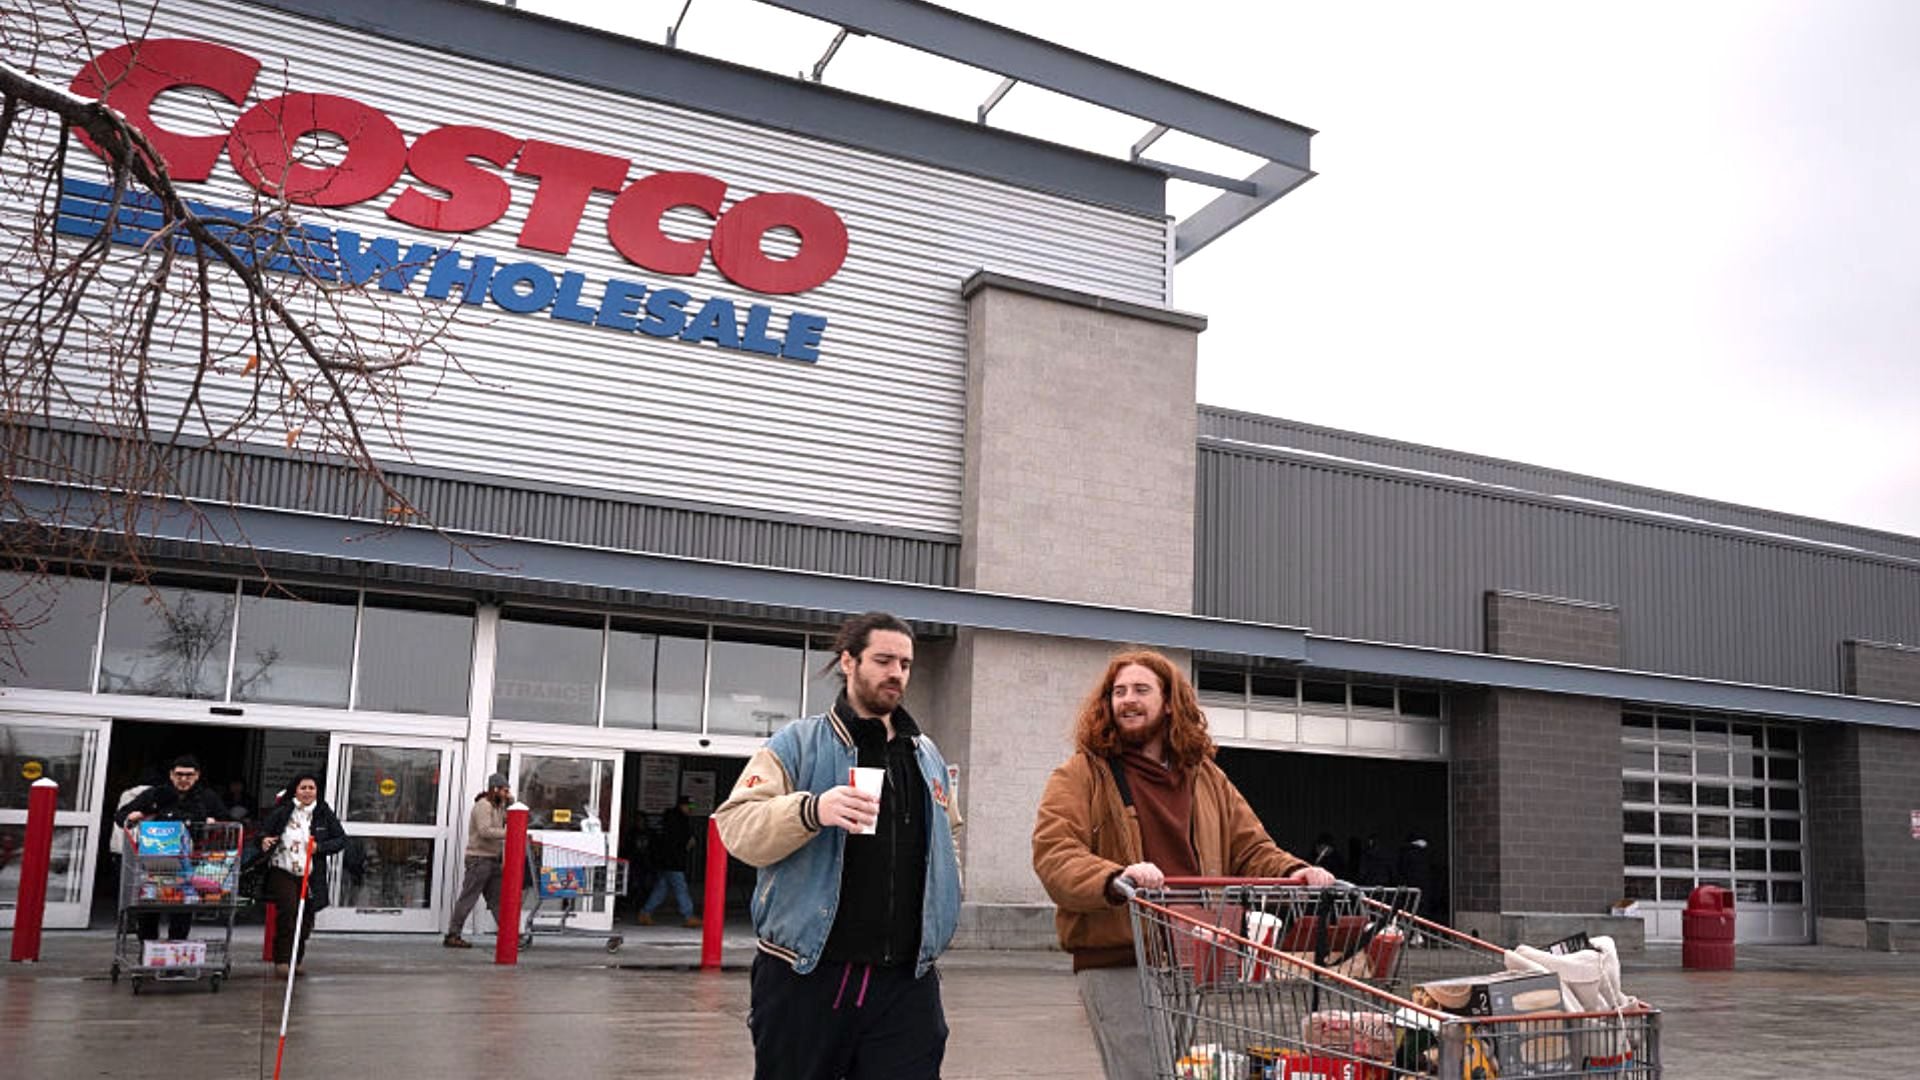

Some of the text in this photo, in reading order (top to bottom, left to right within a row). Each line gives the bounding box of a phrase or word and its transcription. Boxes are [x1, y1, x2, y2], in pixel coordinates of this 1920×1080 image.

[69, 38, 849, 295] COSTCO
[335, 229, 828, 364] WHOLESALE
[496, 679, 594, 703] TRANCE
